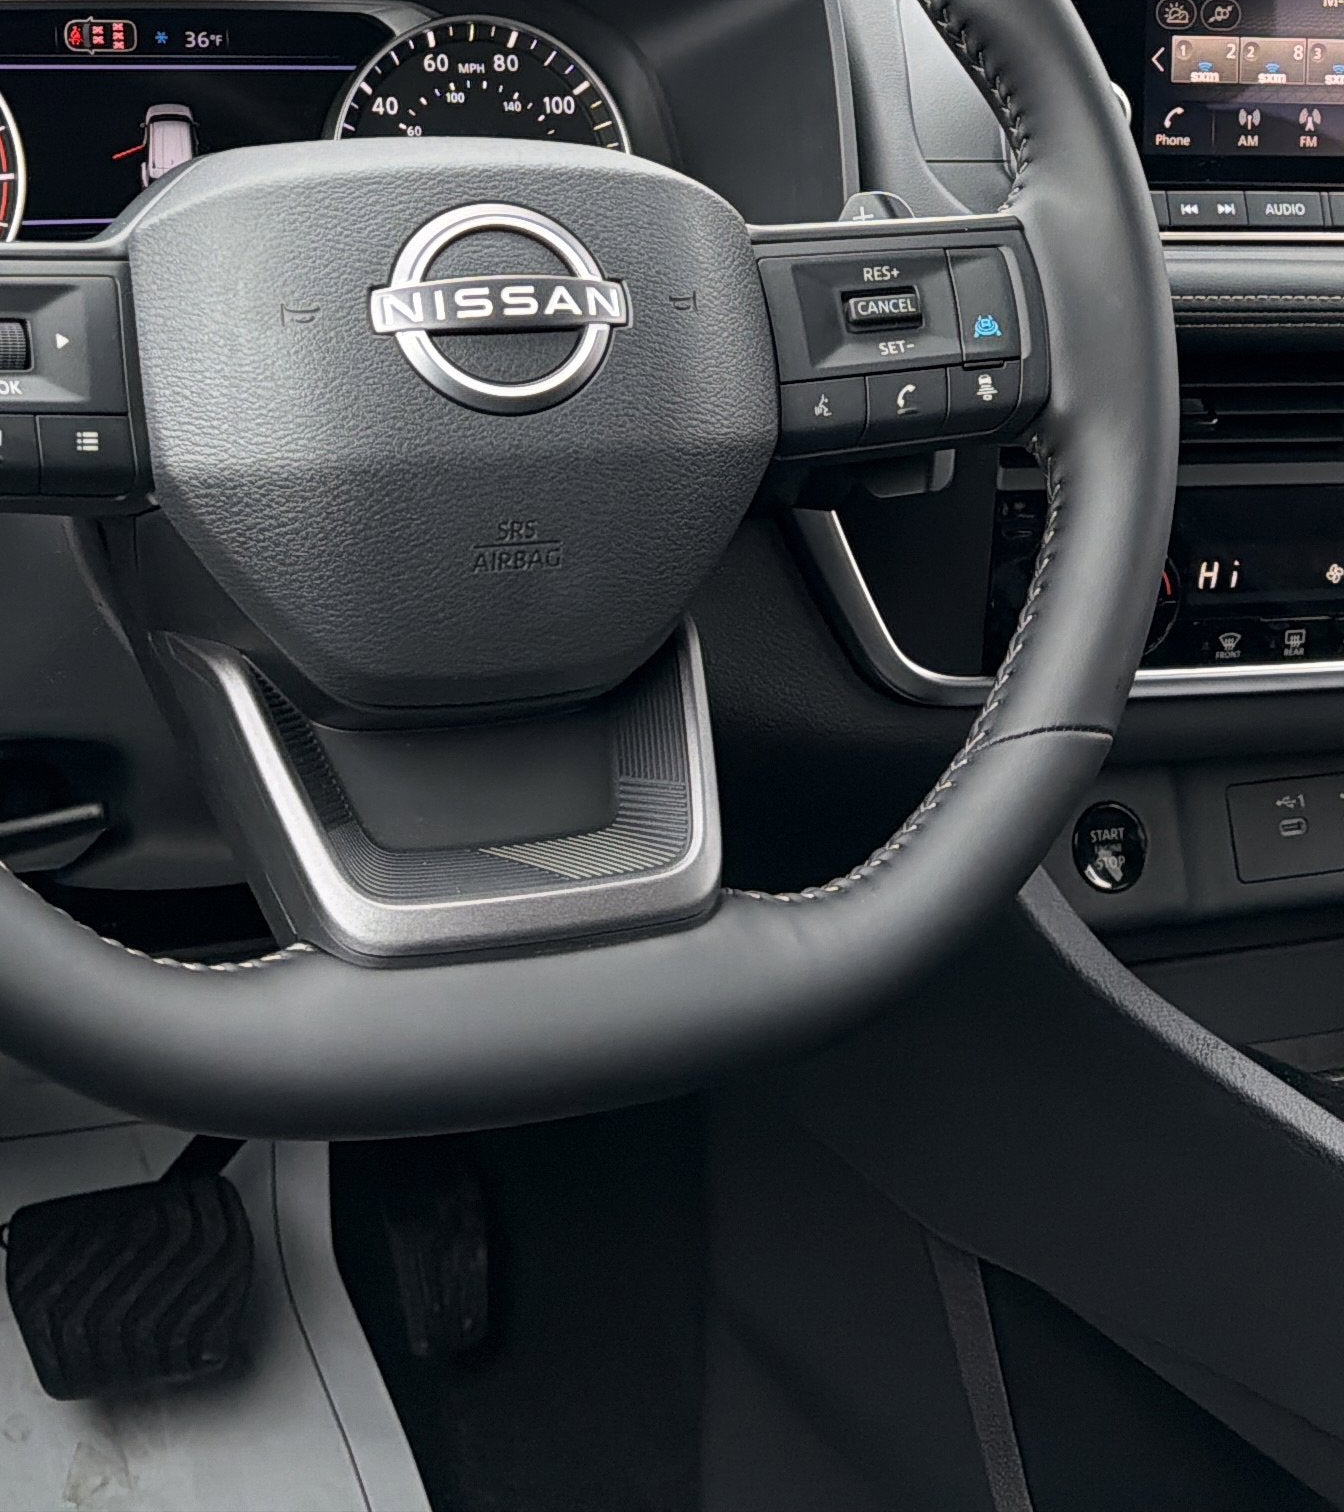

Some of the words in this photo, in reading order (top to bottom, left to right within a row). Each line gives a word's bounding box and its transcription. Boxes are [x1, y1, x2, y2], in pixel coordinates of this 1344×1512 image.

[1226, 44, 1236, 59] 2
[1293, 45, 1304, 61] 8
[423, 53, 449, 72] 60
[458, 62, 485, 74] MPH
[493, 54, 519, 72] 80
[445, 92, 465, 104] 100
[542, 95, 575, 115] 100
[372, 96, 399, 116] 40
[502, 100, 522, 113] 140
[406, 125, 422, 137] 60
[1155, 134, 1191, 147] Phone
[1237, 135, 1258, 147] AM
[1300, 136, 1317, 148] FM
[1265, 203, 1306, 217] AUDIO
[383, 284, 622, 326] NISSAN
[857, 300, 917, 316] CANCEL
[496, 521, 538, 541] SRS
[472, 547, 564, 574] AIRBAG
[1197, 559, 1241, 590] Hi
[1215, 650, 1242, 660] FRONT
[1283, 647, 1305, 656] REAR
[1297, 794, 1305, 807] 1
[1090, 827, 1125, 843] START
[1096, 855, 1126, 870] STOP
